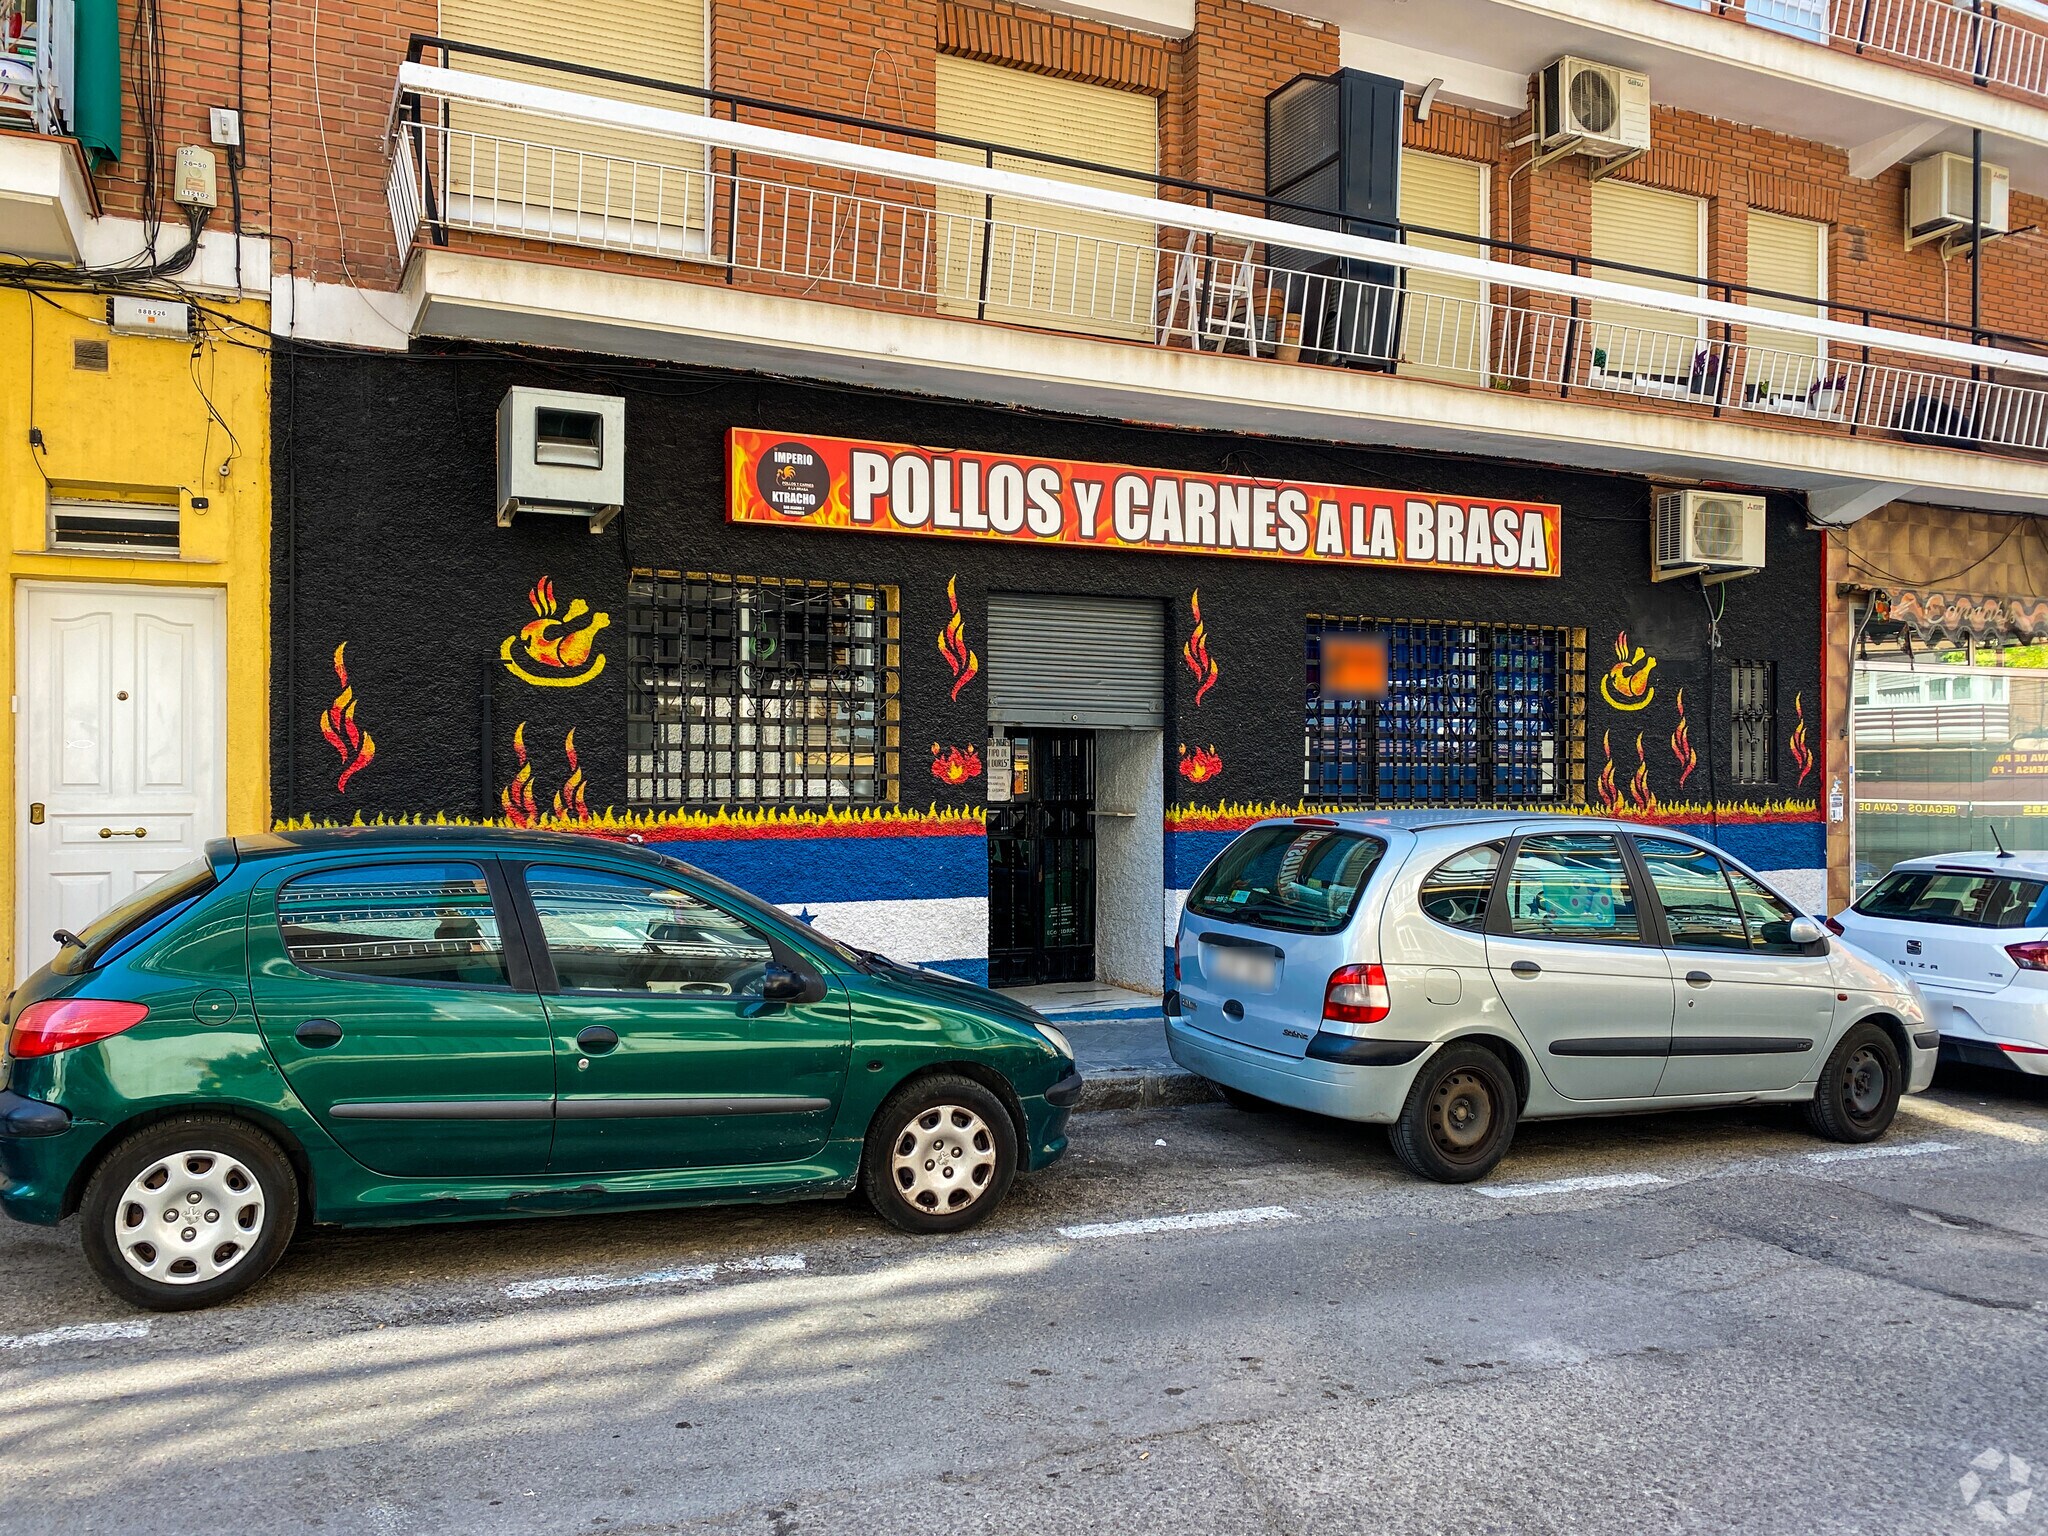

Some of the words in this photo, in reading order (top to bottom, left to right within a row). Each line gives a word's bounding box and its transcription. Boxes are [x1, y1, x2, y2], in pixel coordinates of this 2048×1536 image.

[774, 451, 813, 466] IMPERIO
[772, 490, 816, 506] KTRACHO
[853, 451, 1062, 535] POLLOS
[1073, 481, 1102, 537] Y
[1114, 475, 1308, 552] CARNES
[1316, 503, 1344, 554] A
[1352, 505, 1397, 557] LA
[1406, 501, 1548, 569] BRASA
[1891, 959, 1939, 970] IBIZA
